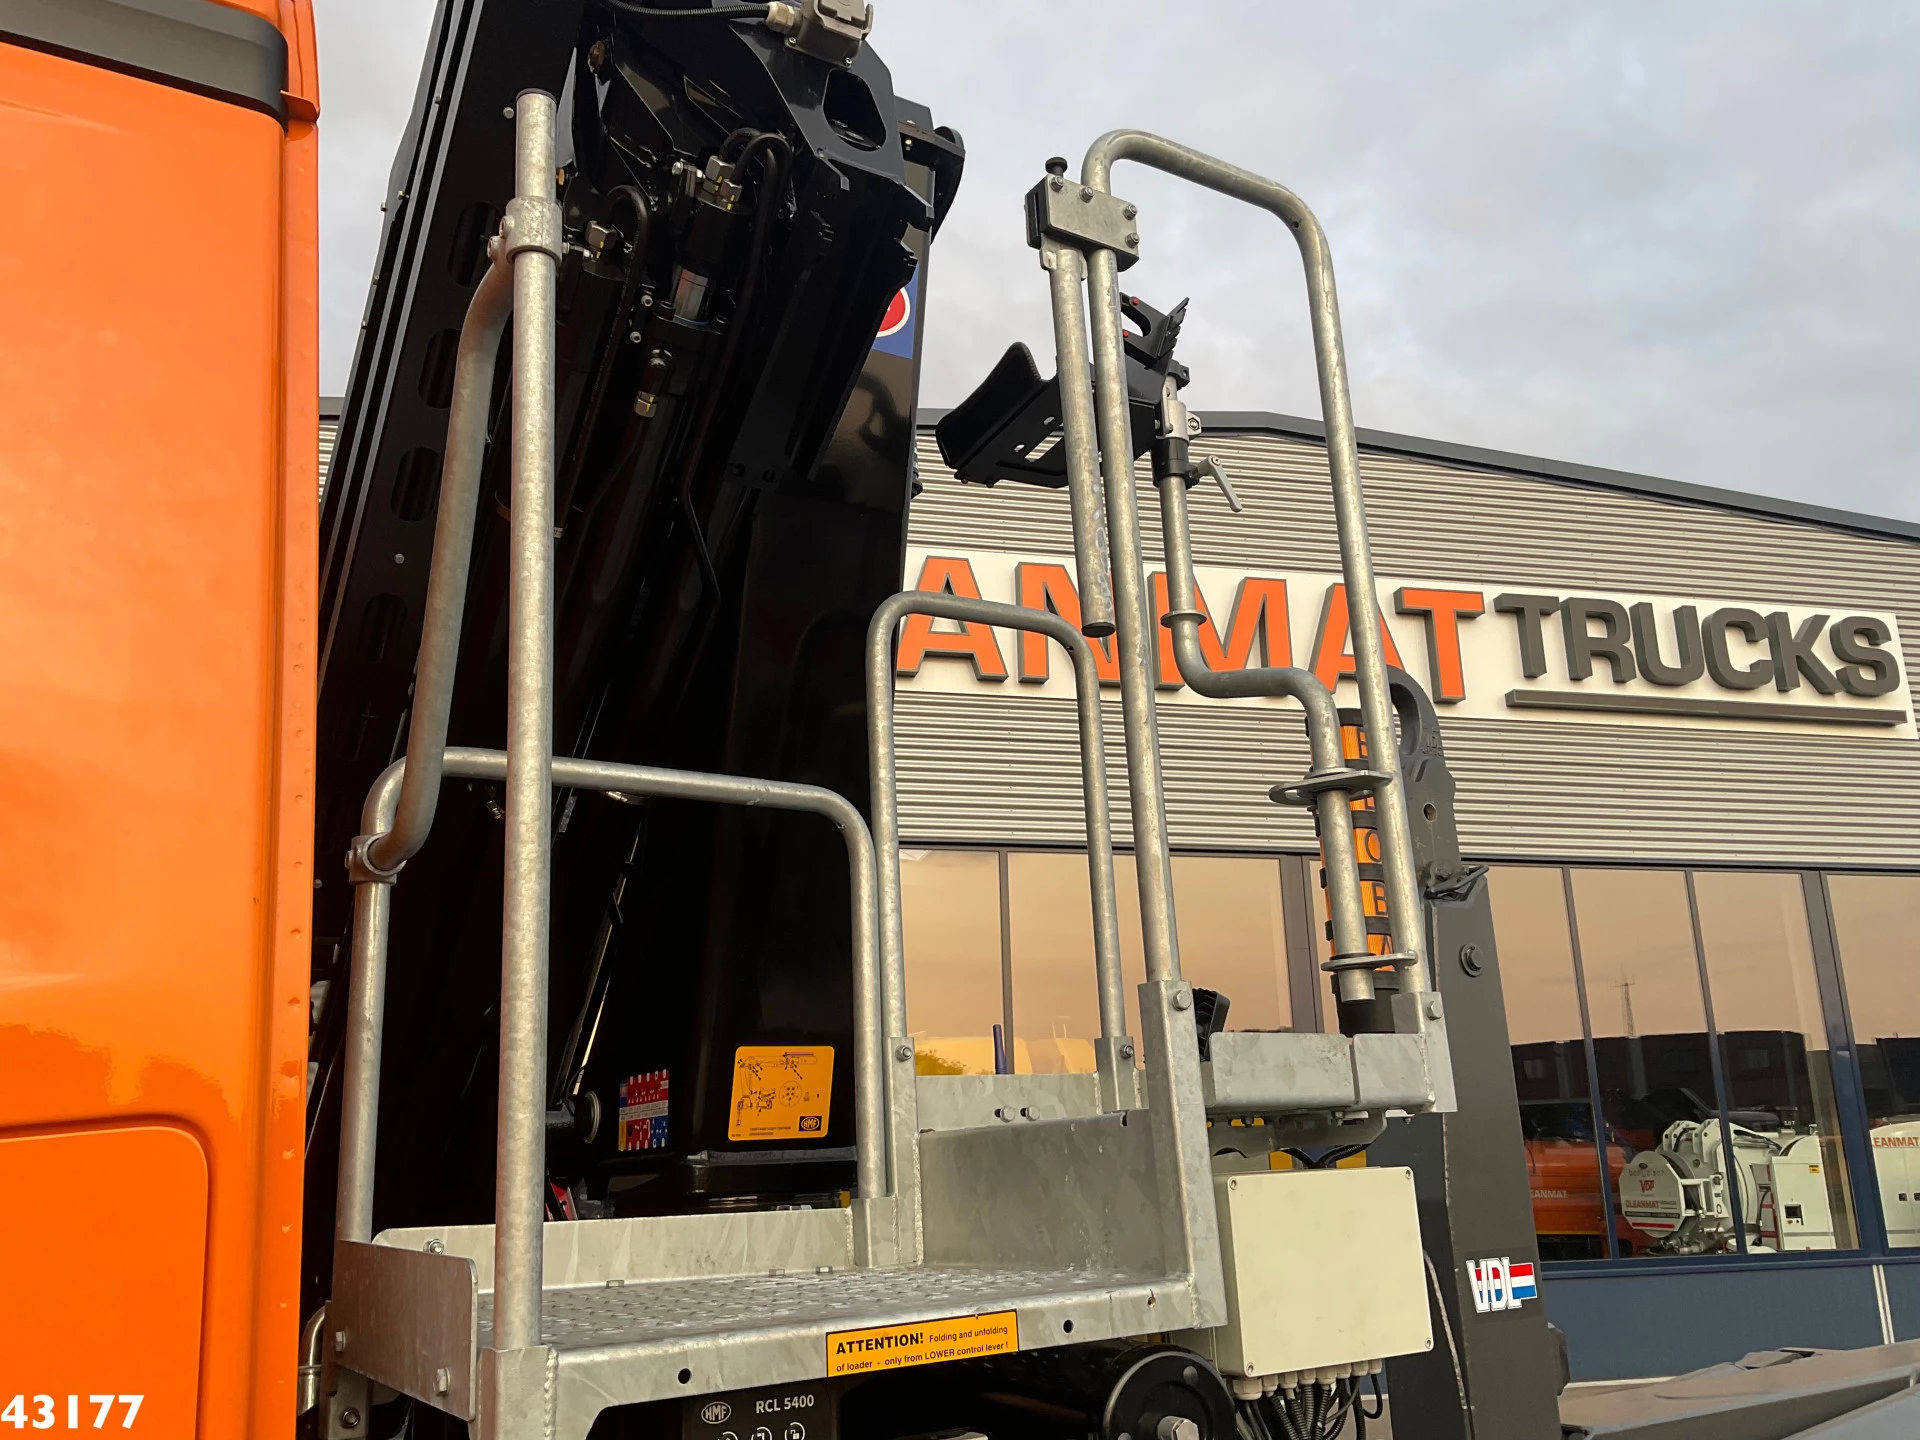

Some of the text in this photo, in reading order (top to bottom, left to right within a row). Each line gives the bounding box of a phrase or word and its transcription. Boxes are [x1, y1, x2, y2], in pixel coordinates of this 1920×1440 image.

[1493, 593, 1900, 697] TRUCKS
[1872, 1136, 1919, 1147] EANMAT
[1466, 1256, 1522, 1313] VDL
[836, 1326, 1008, 1354] ATTENTION! Folding and unfolding
[836, 1362, 845, 1372] of
[846, 1360, 873, 1370] loader
[884, 1356, 902, 1367] only
[904, 1354, 923, 1363] from
[925, 1349, 955, 1360] LOWER
[957, 1346, 984, 1355] control
[985, 1342, 1003, 1351] lever
[704, 1394, 815, 1421] HMF RCL 5400
